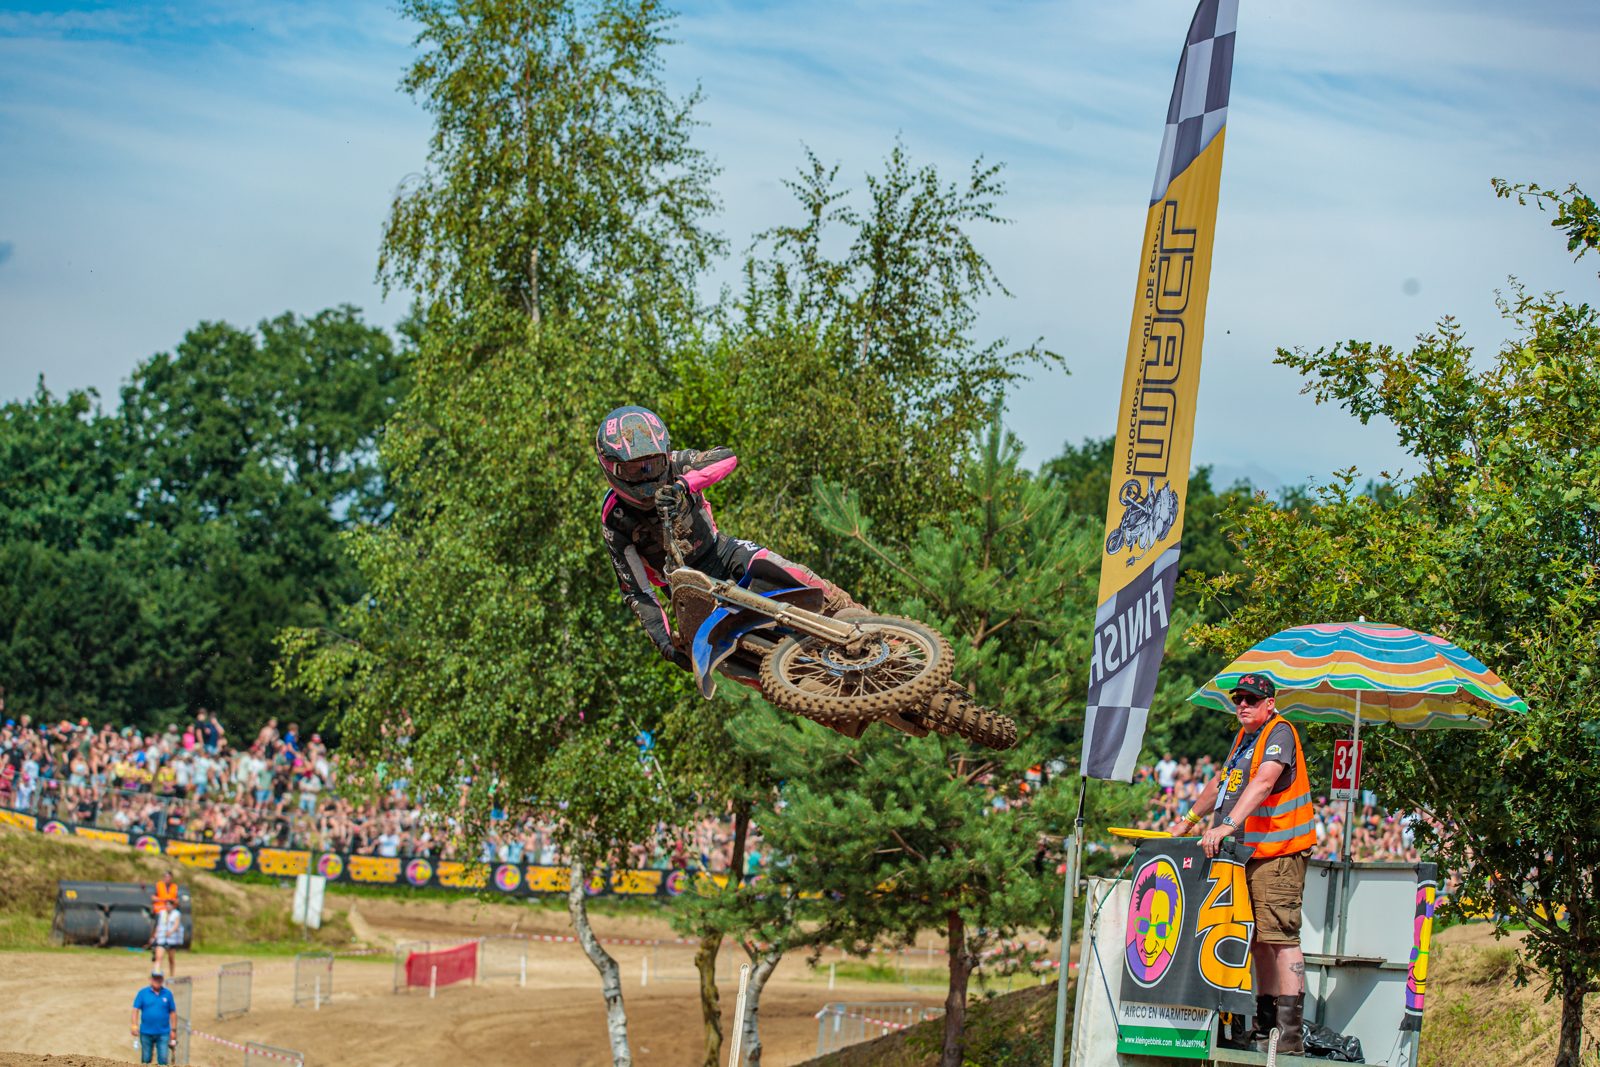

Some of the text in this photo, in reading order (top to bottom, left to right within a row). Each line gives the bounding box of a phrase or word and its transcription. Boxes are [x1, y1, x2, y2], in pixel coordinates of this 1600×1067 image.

[1335, 745, 1358, 780] 32
[1125, 1005, 1147, 1019] AIRCO
[1148, 1006, 1158, 1019] EN
